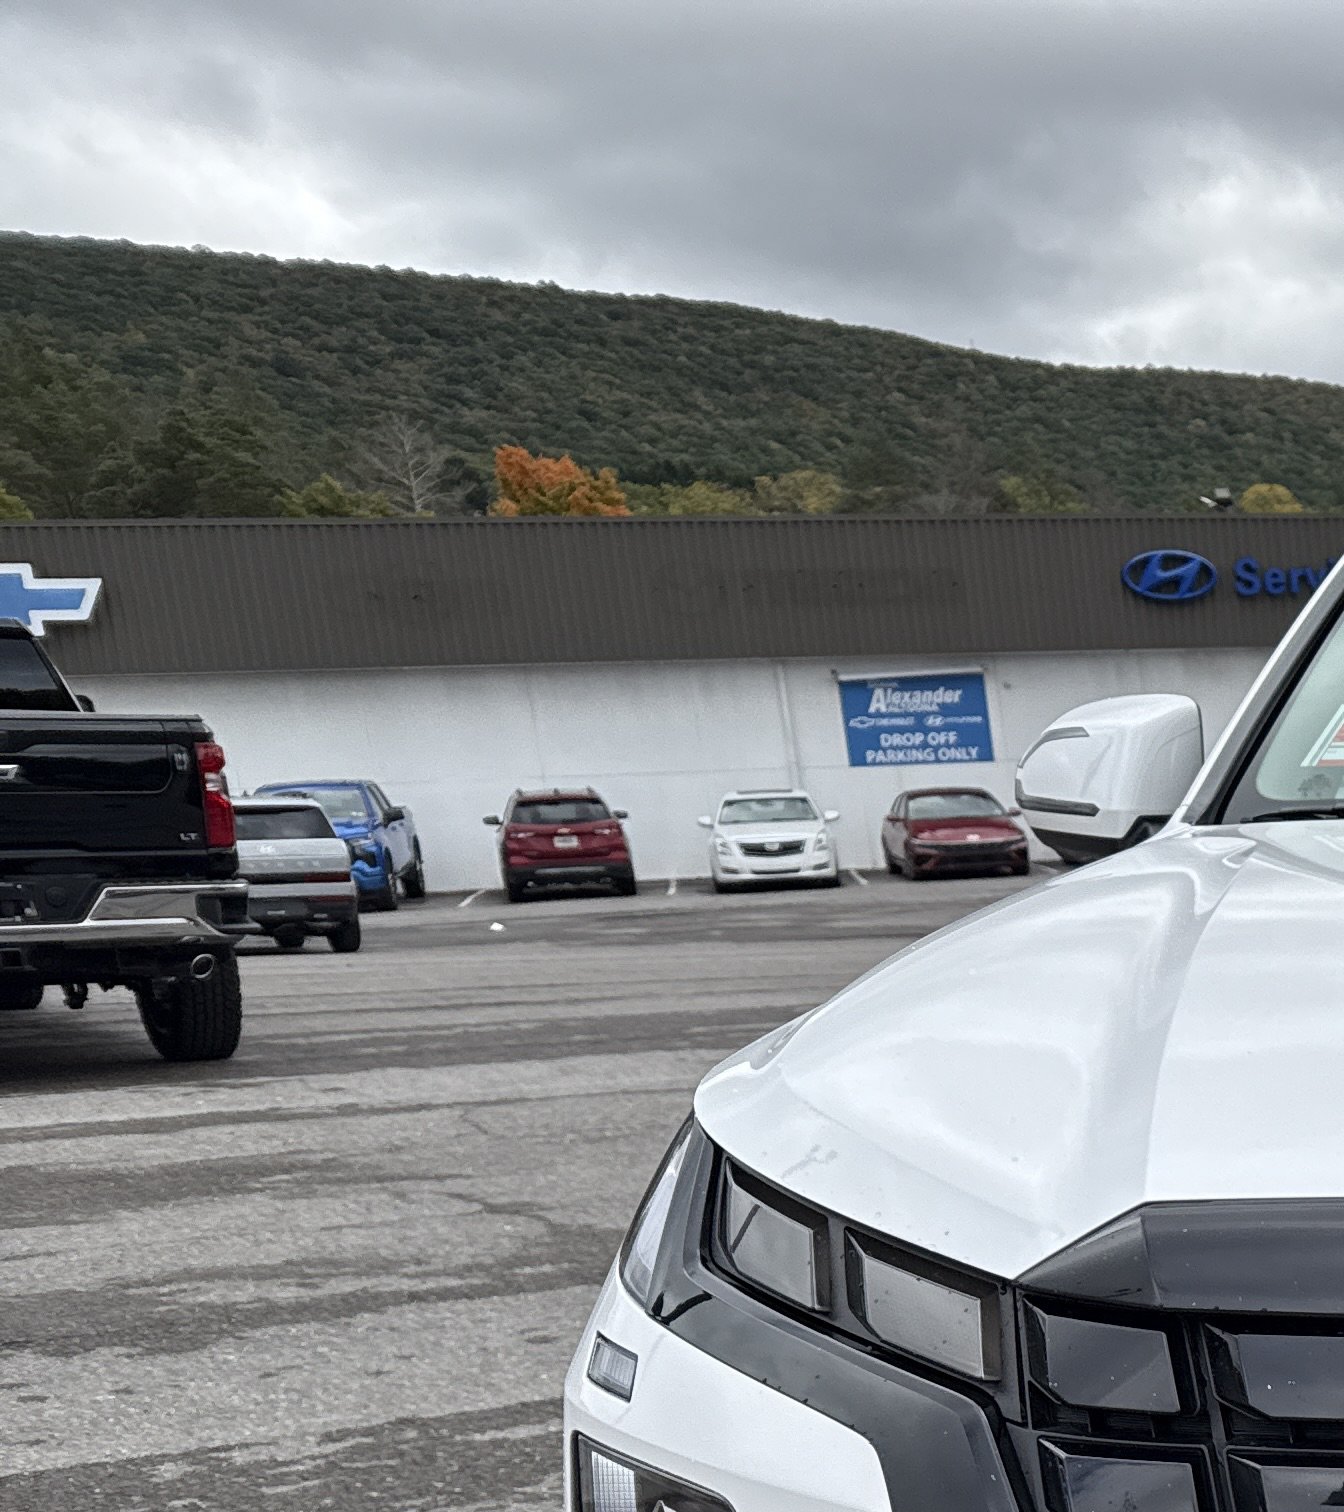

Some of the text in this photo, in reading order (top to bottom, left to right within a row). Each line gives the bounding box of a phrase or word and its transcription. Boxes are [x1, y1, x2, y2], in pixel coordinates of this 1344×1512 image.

[868, 686, 962, 713] Alexander
[880, 731, 957, 747] DROP OFF
[865, 746, 978, 763] PARKING ONLY
